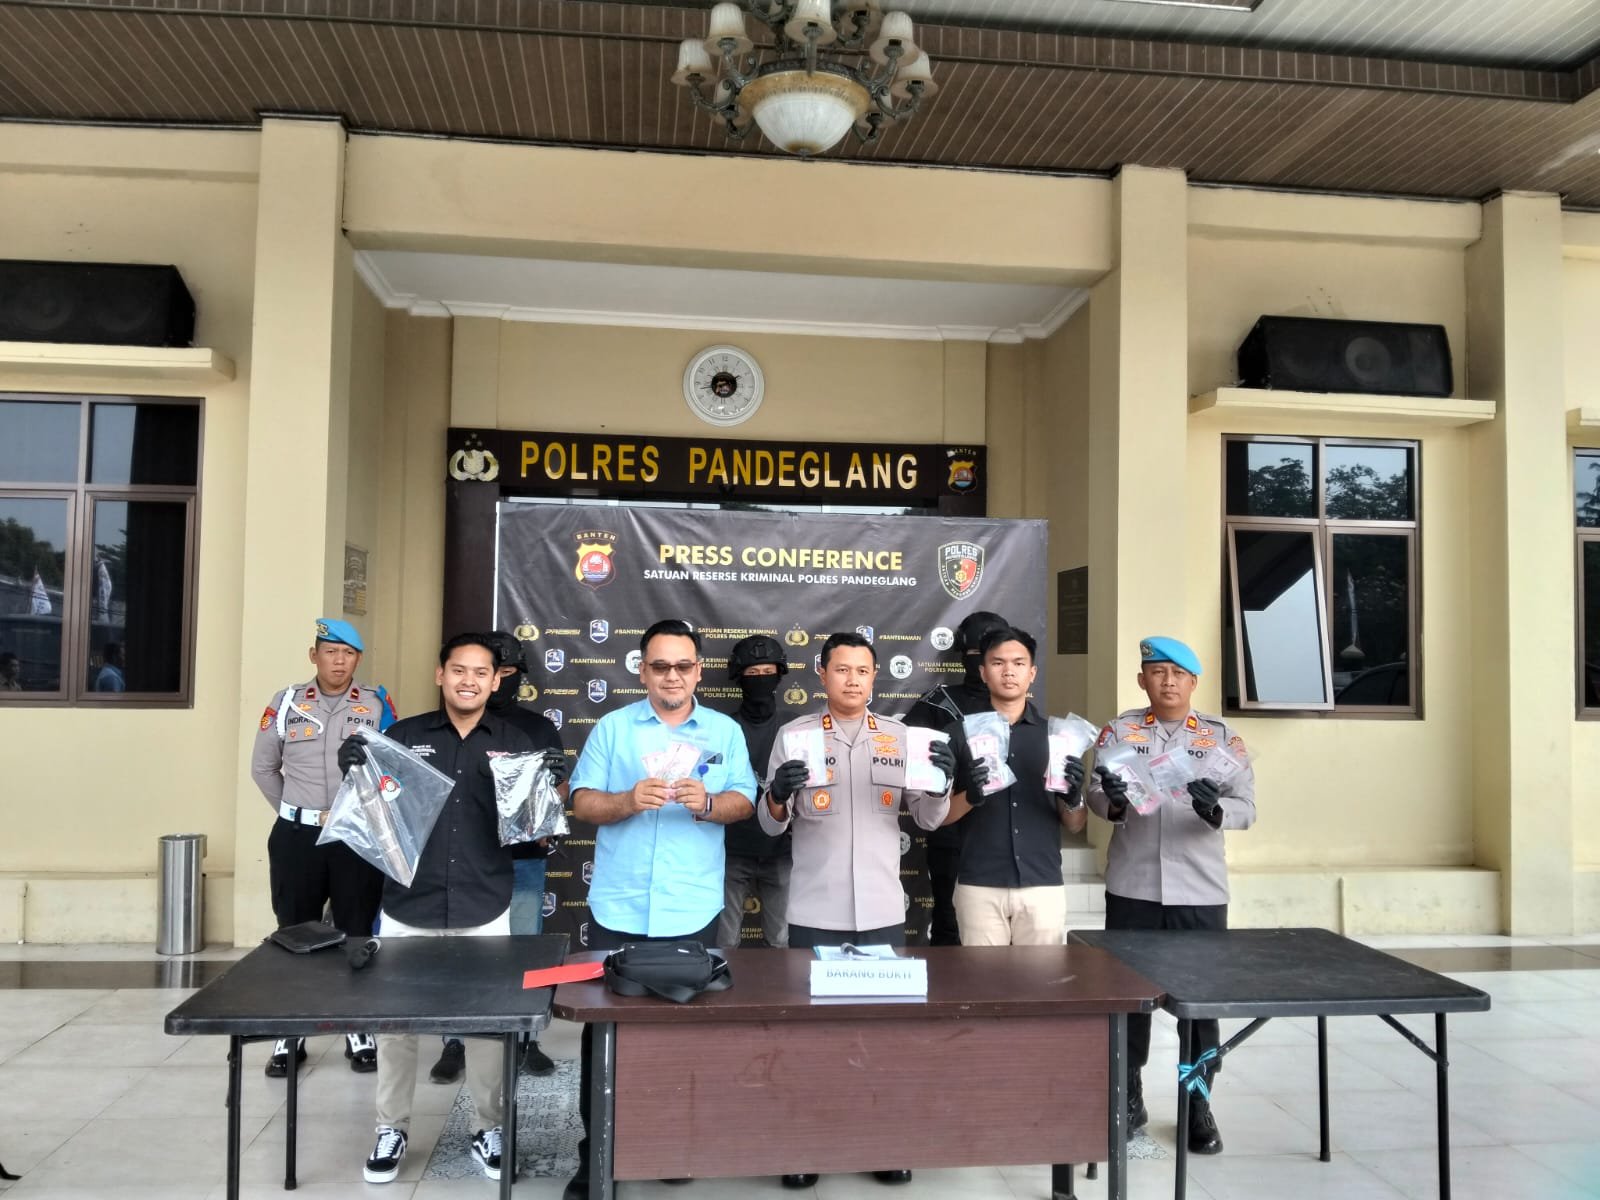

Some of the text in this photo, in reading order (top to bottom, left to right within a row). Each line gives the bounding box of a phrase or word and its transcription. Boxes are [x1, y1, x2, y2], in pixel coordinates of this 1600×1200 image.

[521, 440, 918, 490] POLRES PANDEGLANG
[576, 532, 616, 541] BANTEN
[660, 544, 903, 571] PRESS CONFERENCE
[945, 545, 978, 557] POLRES
[644, 569, 917, 587] SATUAN RESERSE KRIMINAL POLRES PANDEGLANG
[873, 756, 904, 768] POLRI
[826, 967, 912, 980] BARANG BUKTI
